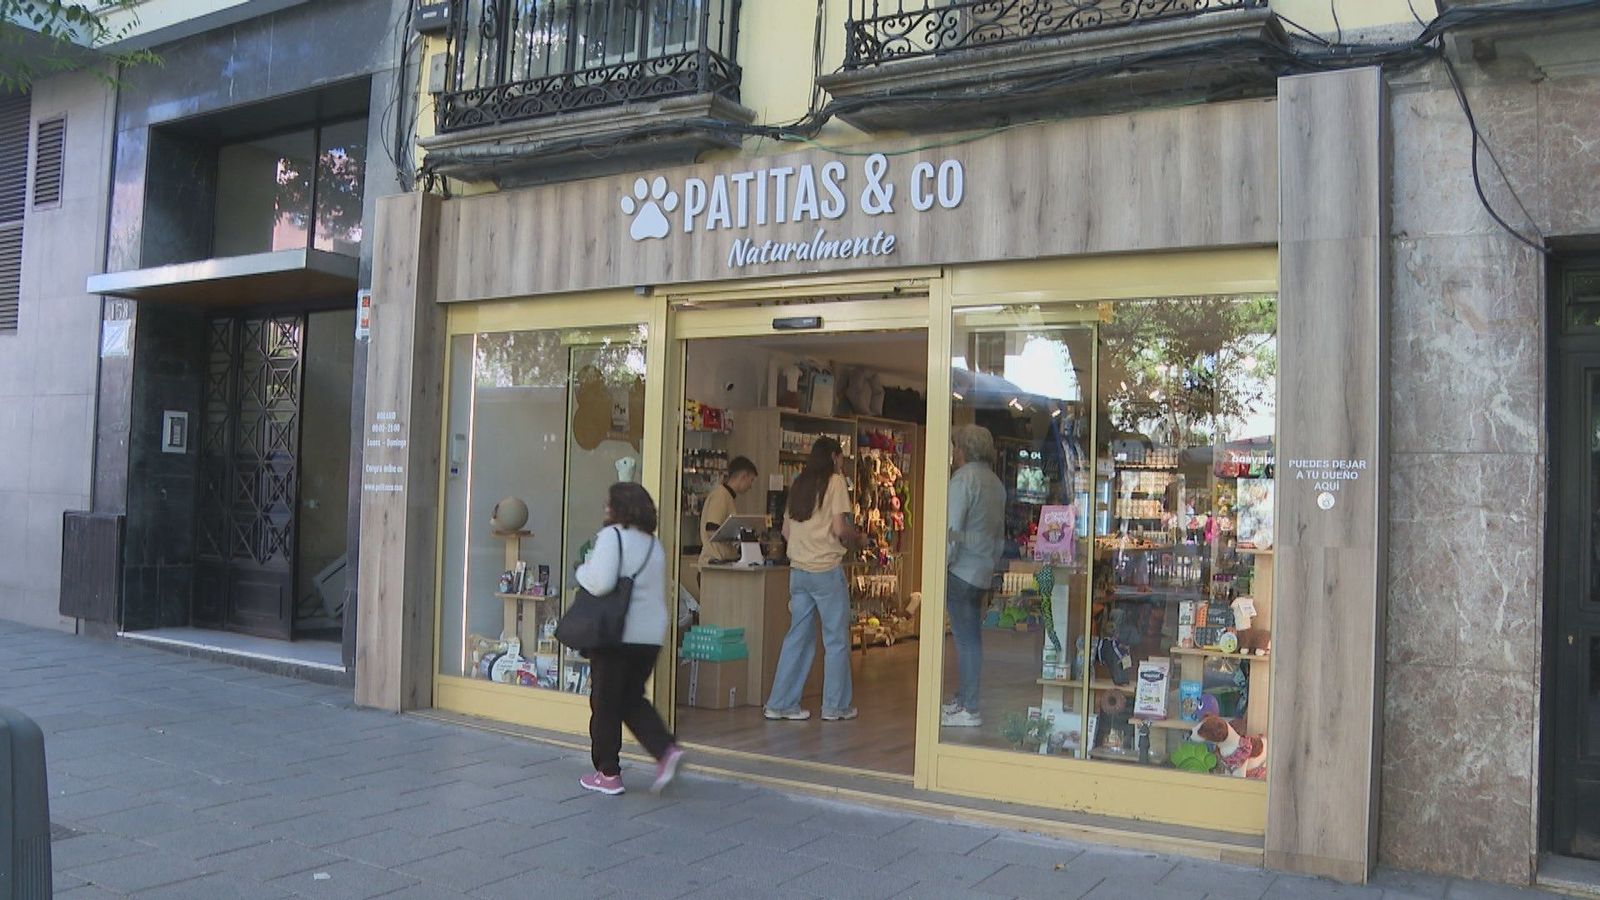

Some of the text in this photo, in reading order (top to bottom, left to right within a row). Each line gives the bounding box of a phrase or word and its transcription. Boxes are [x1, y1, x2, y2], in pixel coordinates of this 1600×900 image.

[683, 153, 963, 233] PATITAS & CO
[727, 228, 896, 268] Naturalmente
[1288, 459, 1367, 469] PUEDES DEJAR
[1296, 470, 1304, 480] A
[1306, 470, 1319, 480] TU
